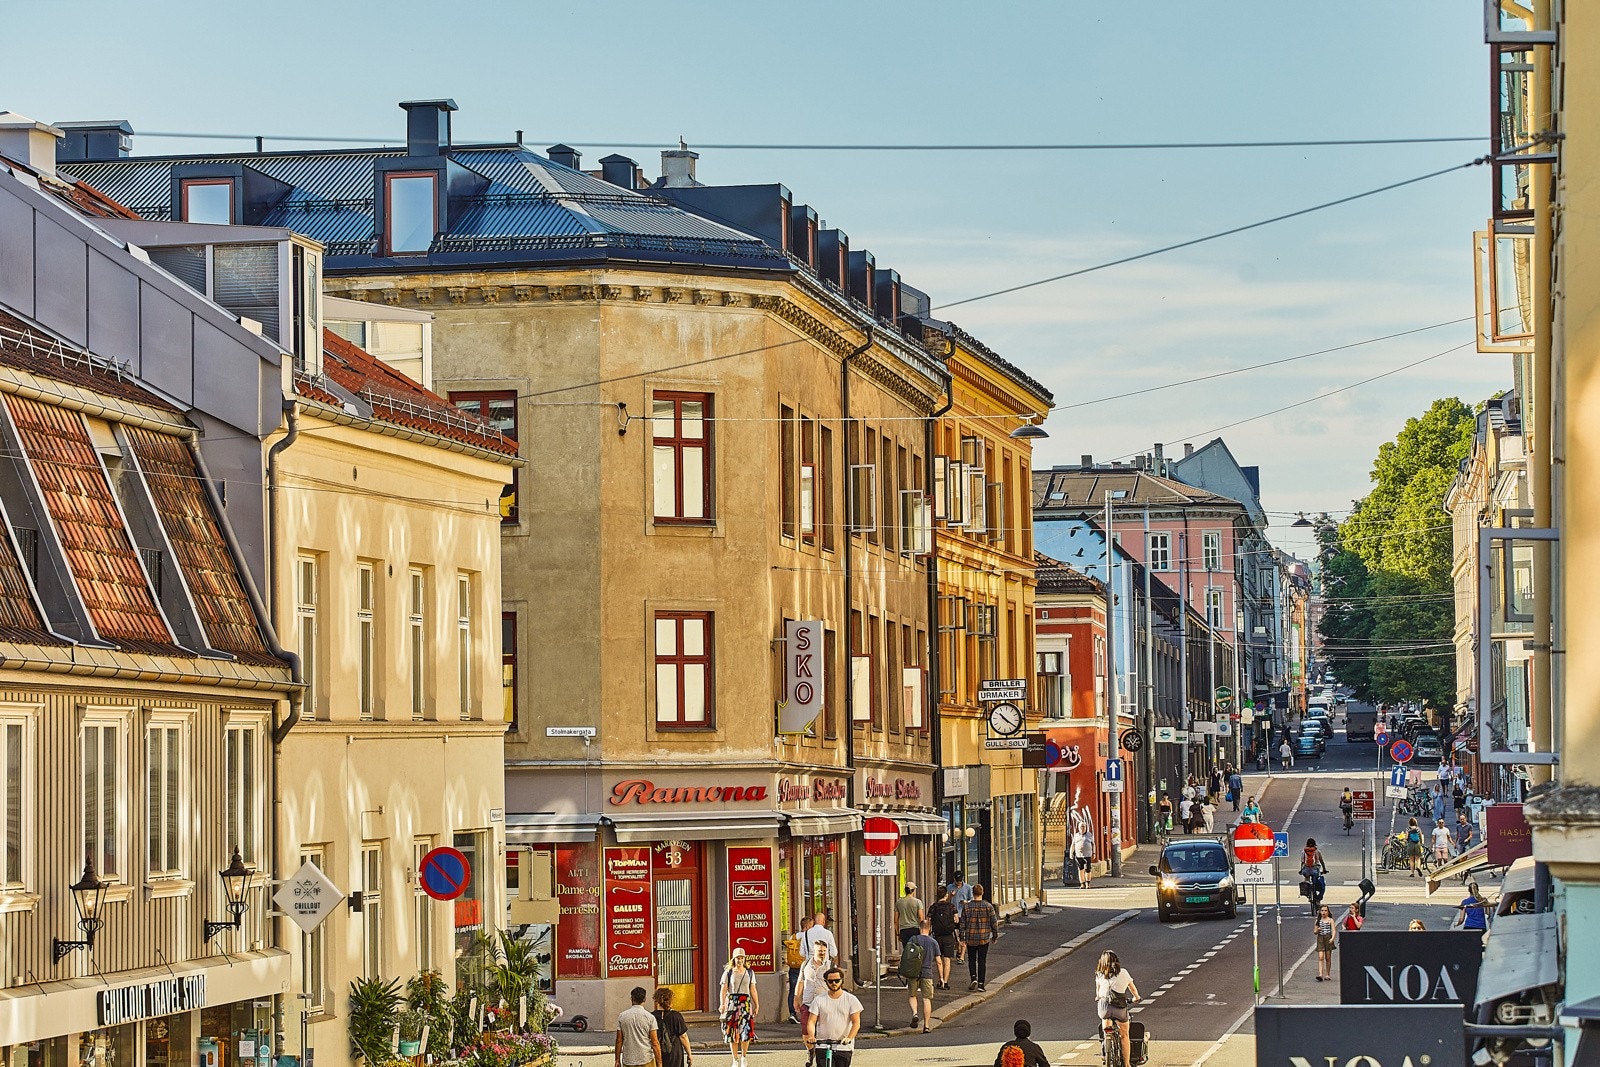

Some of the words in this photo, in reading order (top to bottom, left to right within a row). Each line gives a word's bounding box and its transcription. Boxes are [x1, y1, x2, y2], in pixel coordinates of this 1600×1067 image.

[795, 627, 814, 704] SKO
[989, 680, 1021, 688] BRILLER
[980, 690, 1019, 699] URMAKER
[551, 728, 592, 736] Stolmakergata
[609, 779, 768, 806] Ramona
[780, 777, 811, 803] Ramona
[655, 840, 692, 854] MARKVEIEN
[665, 851, 682, 865] 53
[567, 868, 584, 877] ALT
[294, 902, 321, 910] CHILLOUT
[613, 904, 643, 913] GALLUS
[658, 906, 691, 916] Ramona
[734, 920, 769, 929] HERRESKO
[608, 954, 648, 965] Ramona
[745, 953, 771, 961] amona
[609, 963, 649, 971] SKOSALON
[1363, 964, 1459, 1001] NOA
[103, 984, 147, 1026] CHILLOUT
[149, 977, 182, 1017] TRAVEL
